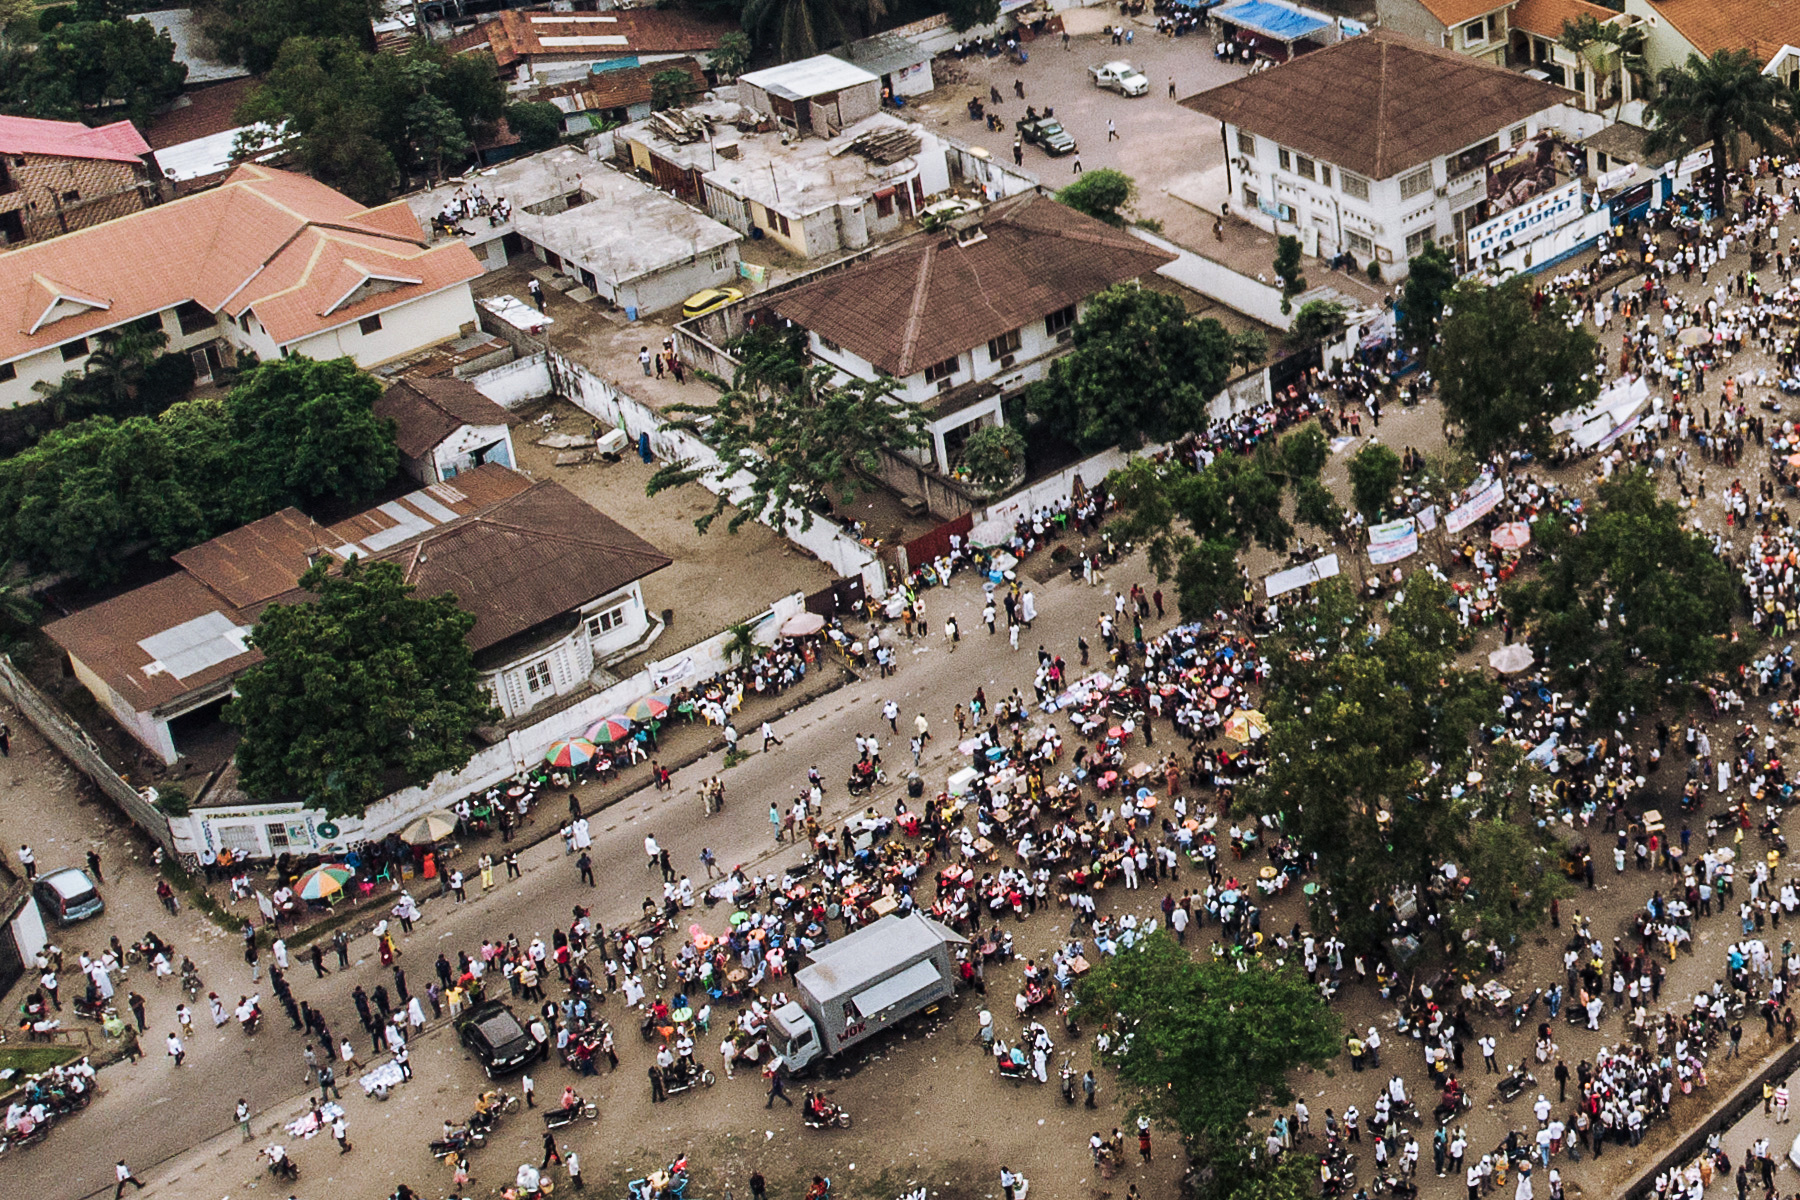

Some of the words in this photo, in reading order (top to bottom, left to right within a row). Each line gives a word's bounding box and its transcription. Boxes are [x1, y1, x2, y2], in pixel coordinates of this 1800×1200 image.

[1481, 200, 1571, 249] D'ABORD
[1486, 185, 1578, 235] PEUPLE
[837, 1020, 867, 1042] WOK
